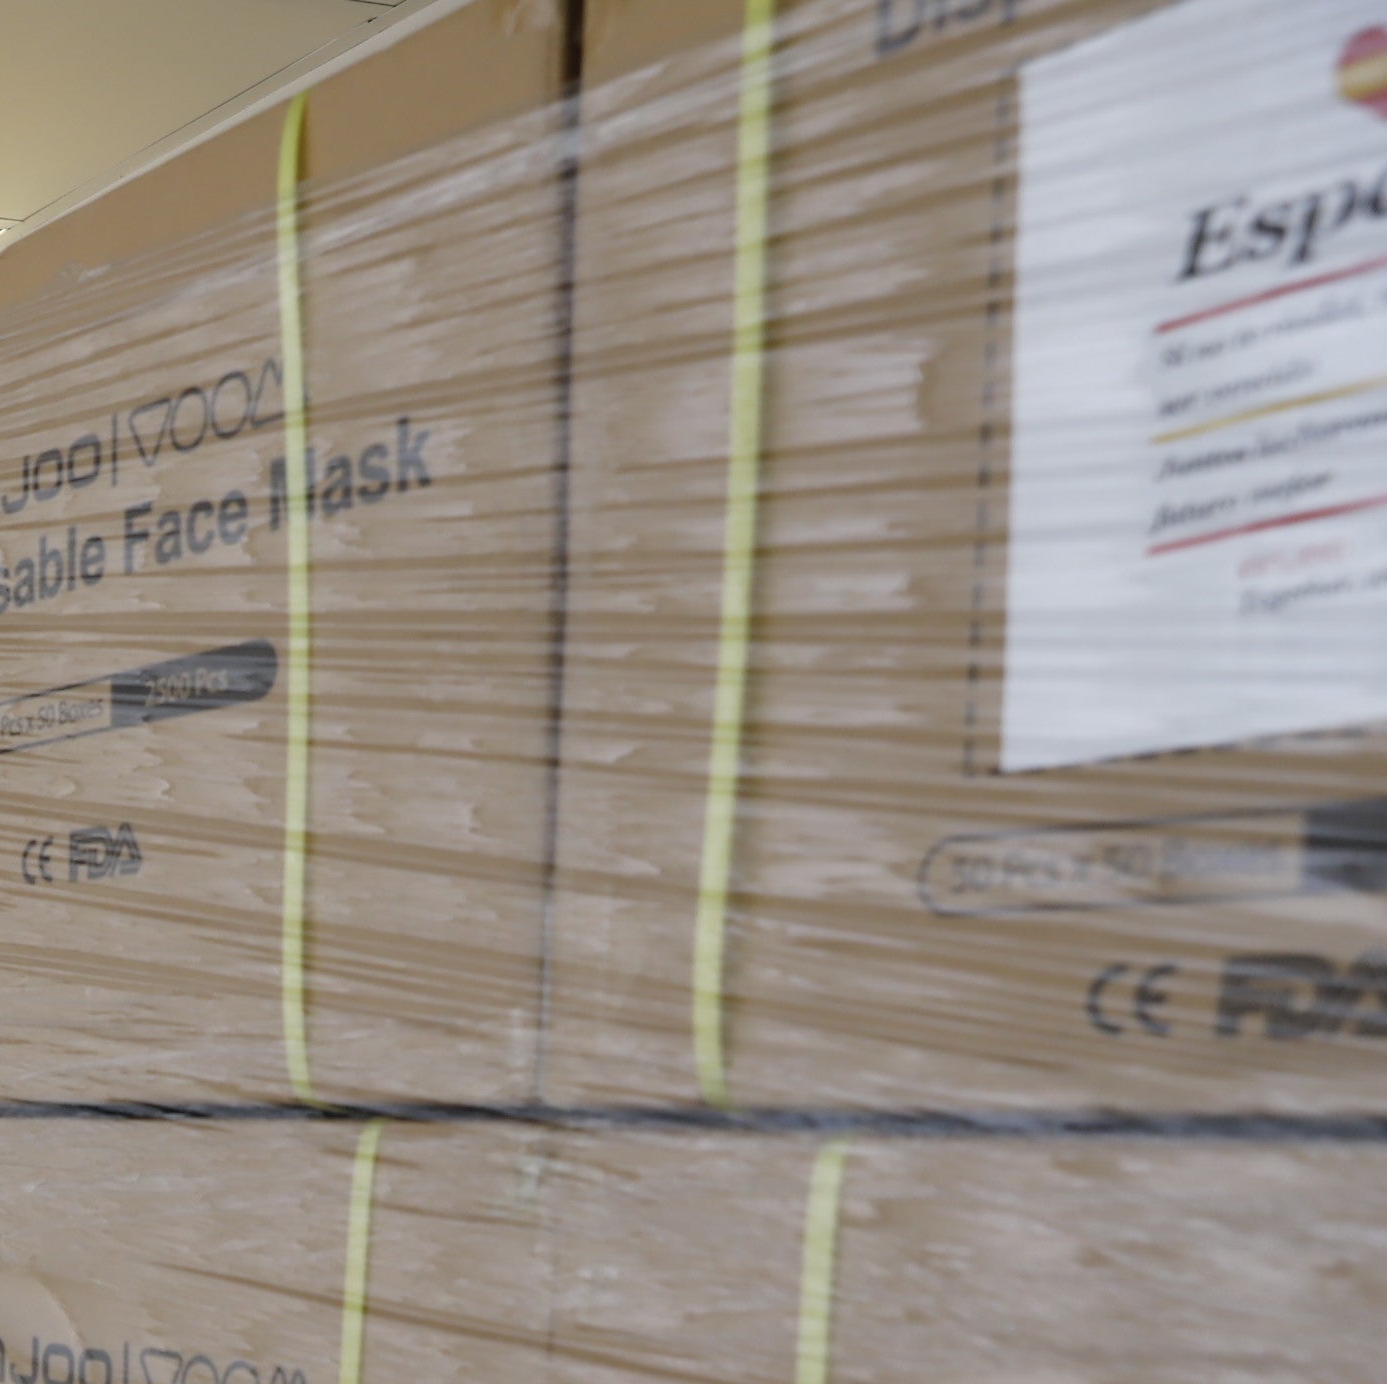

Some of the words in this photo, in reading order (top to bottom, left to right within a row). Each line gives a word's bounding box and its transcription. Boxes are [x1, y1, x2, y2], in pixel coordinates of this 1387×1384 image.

[123, 489, 248, 577] Face
[0, 716, 23, 739] Pcs
[196, 666, 227, 694] Pcs
[68, 822, 144, 882] FDA
